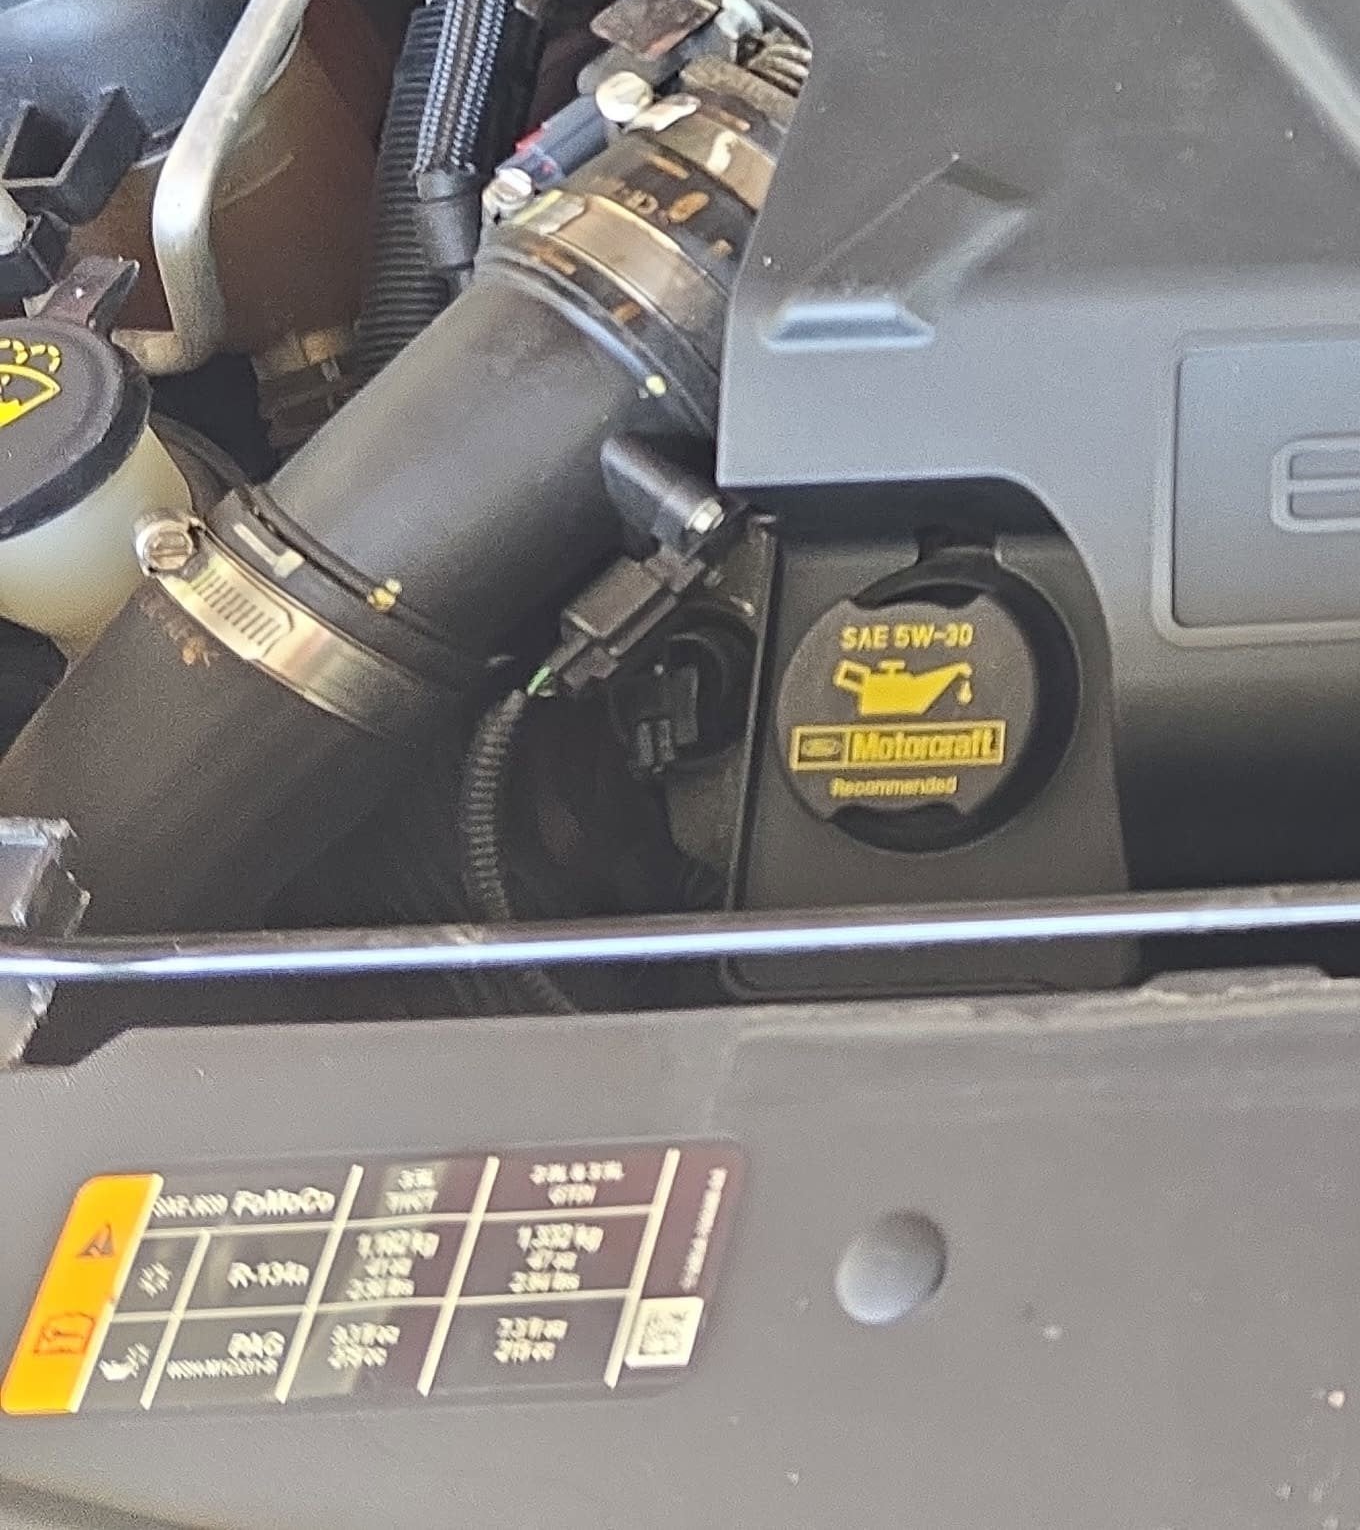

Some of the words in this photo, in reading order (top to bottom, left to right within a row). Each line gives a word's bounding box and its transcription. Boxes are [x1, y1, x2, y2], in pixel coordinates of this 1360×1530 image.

[840, 625, 889, 651] SAE
[894, 622, 974, 648] 5W-30
[851, 727, 996, 761] Motorcraft
